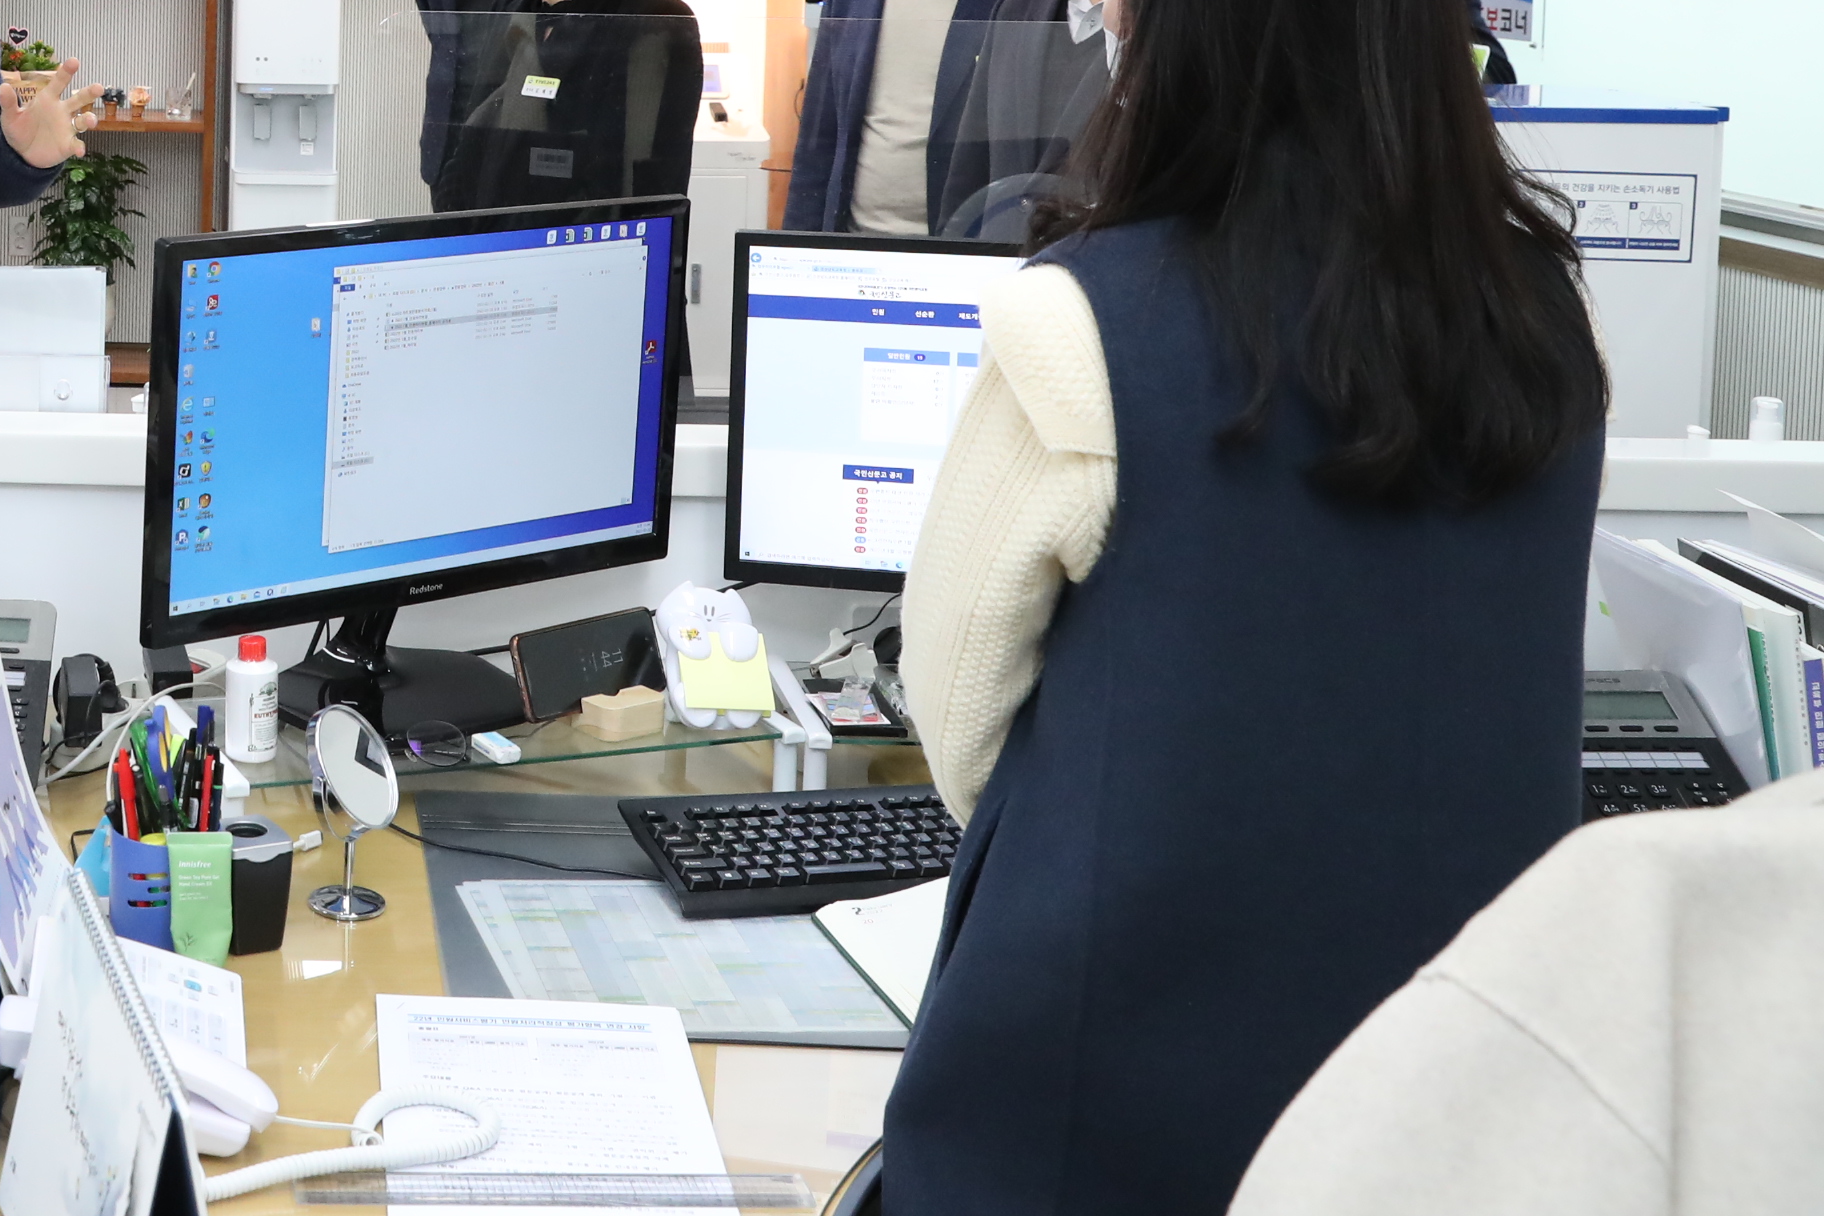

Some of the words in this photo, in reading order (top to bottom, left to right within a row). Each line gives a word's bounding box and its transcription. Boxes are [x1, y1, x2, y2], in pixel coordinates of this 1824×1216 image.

[1481, 7, 1528, 35] 보코너
[409, 584, 443, 595] Redstone
[179, 860, 212, 868] innisfree
